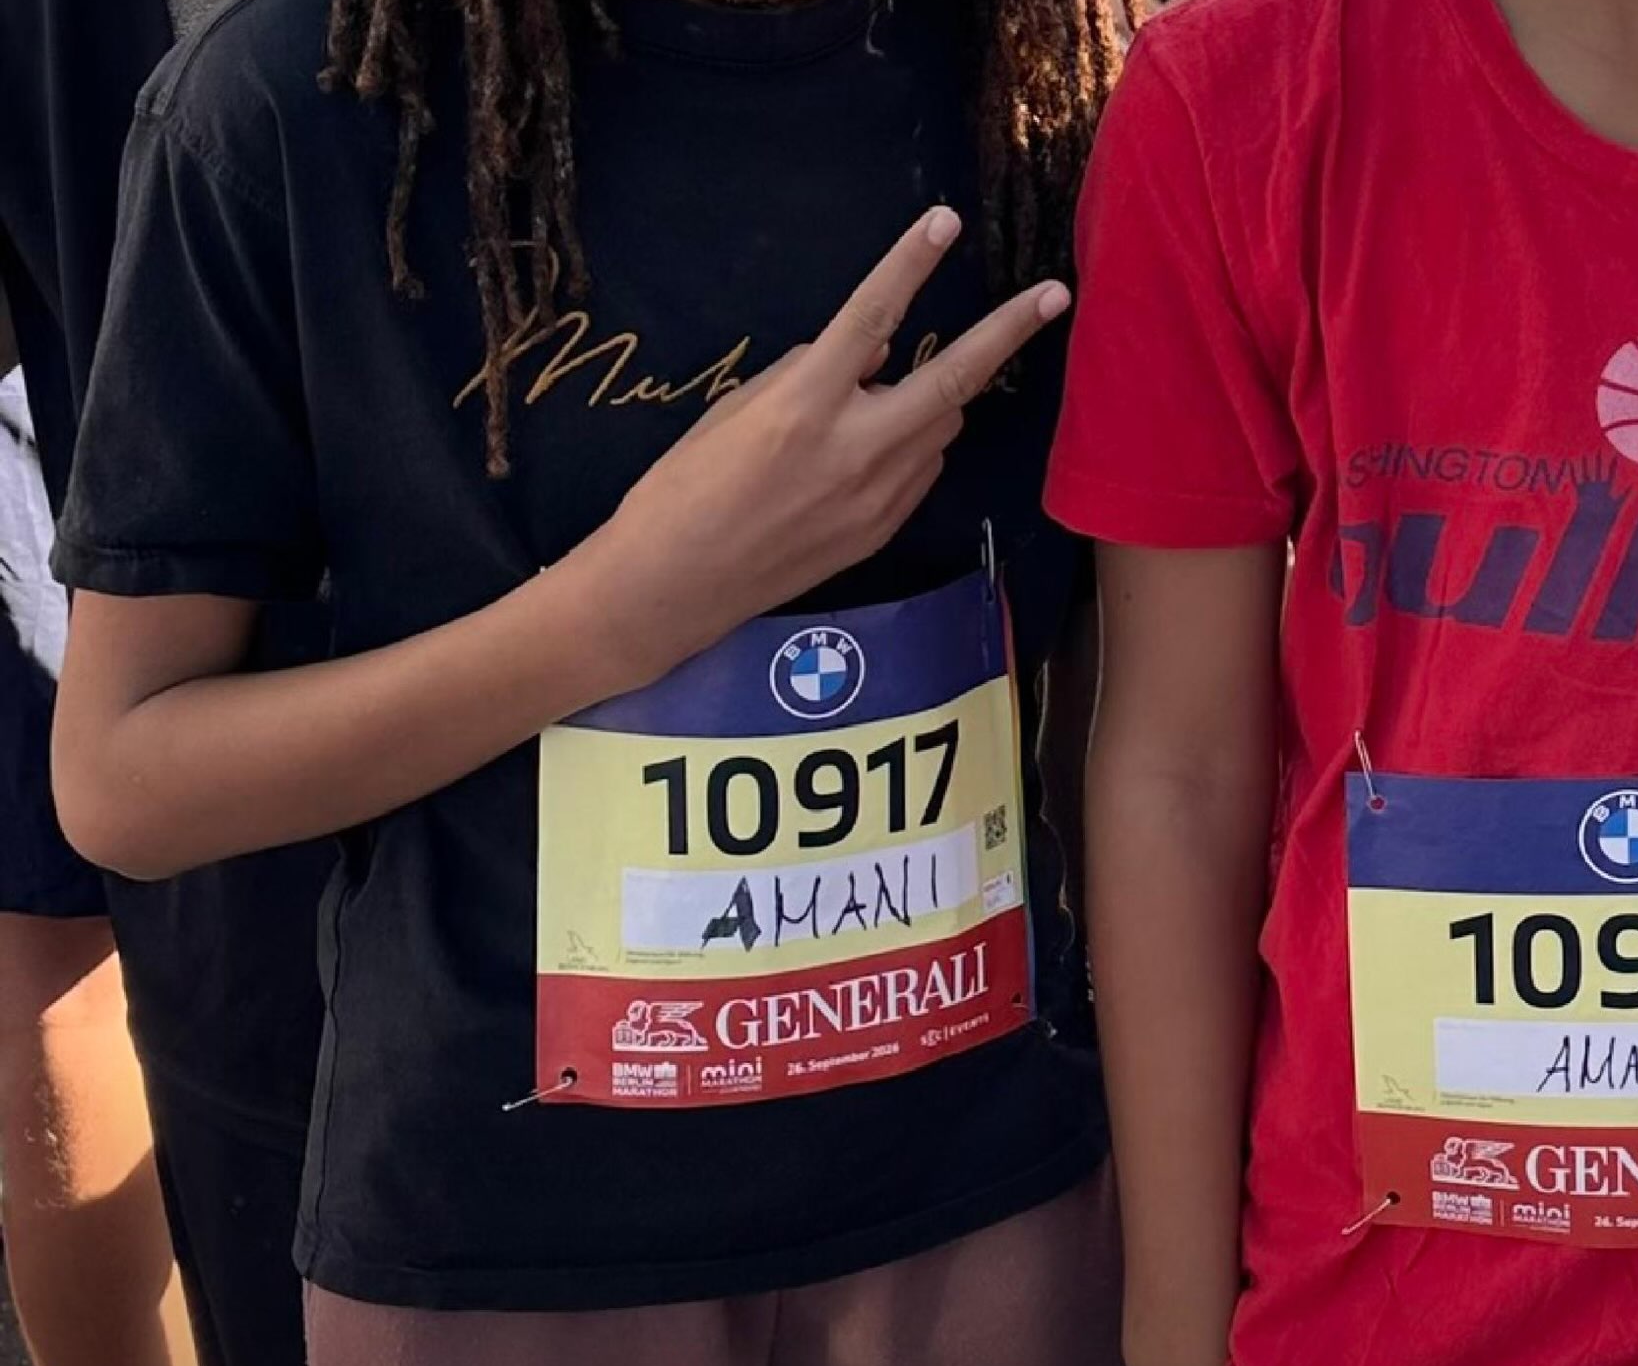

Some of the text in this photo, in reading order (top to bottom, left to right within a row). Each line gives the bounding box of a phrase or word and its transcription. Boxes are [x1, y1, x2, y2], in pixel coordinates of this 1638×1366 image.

[643, 719, 960, 856] 10917
[701, 855, 939, 953] AMANI
[715, 942, 989, 1050] GENERALI
[701, 1056, 762, 1078] mini
[808, 1049, 870, 1073] September
[1513, 1201, 1571, 1221] mini
